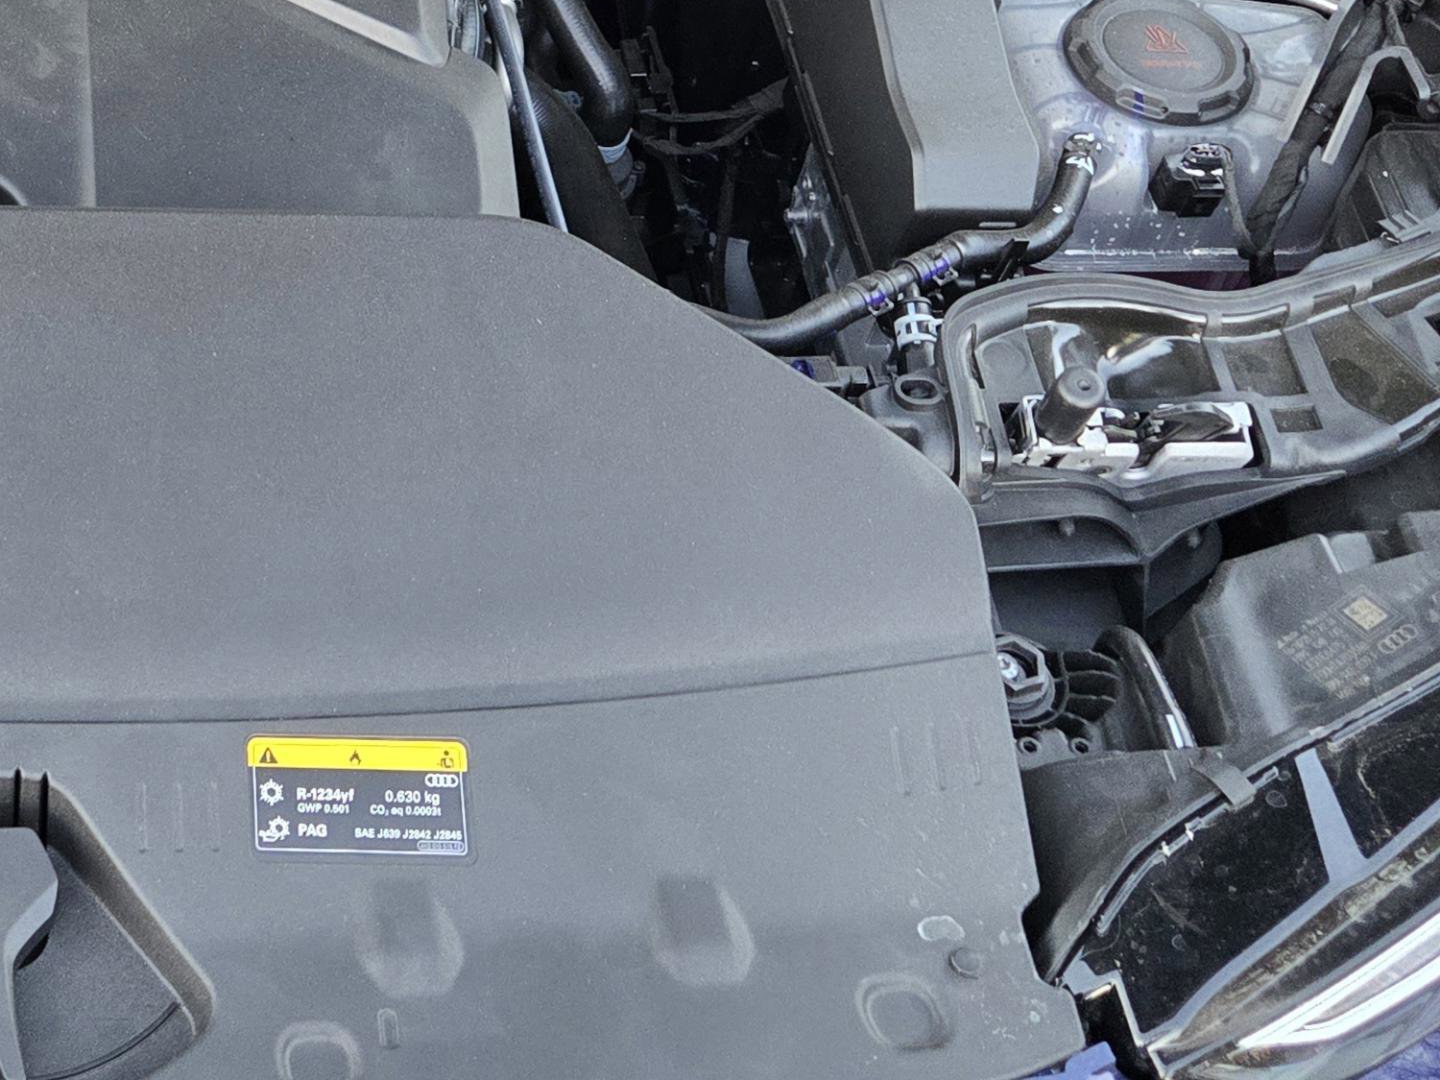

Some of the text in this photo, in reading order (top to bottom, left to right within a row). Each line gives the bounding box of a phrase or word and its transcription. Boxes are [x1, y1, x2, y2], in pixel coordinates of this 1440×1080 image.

[296, 787, 354, 804] R-1234yf
[385, 790, 440, 806] 0.630 kg
[297, 803, 322, 813] GWP
[390, 807, 404, 817] eq
[298, 823, 328, 837] PAG
[354, 827, 375, 838] SAE
[377, 828, 401, 839] J639
[402, 829, 432, 839] J2842
